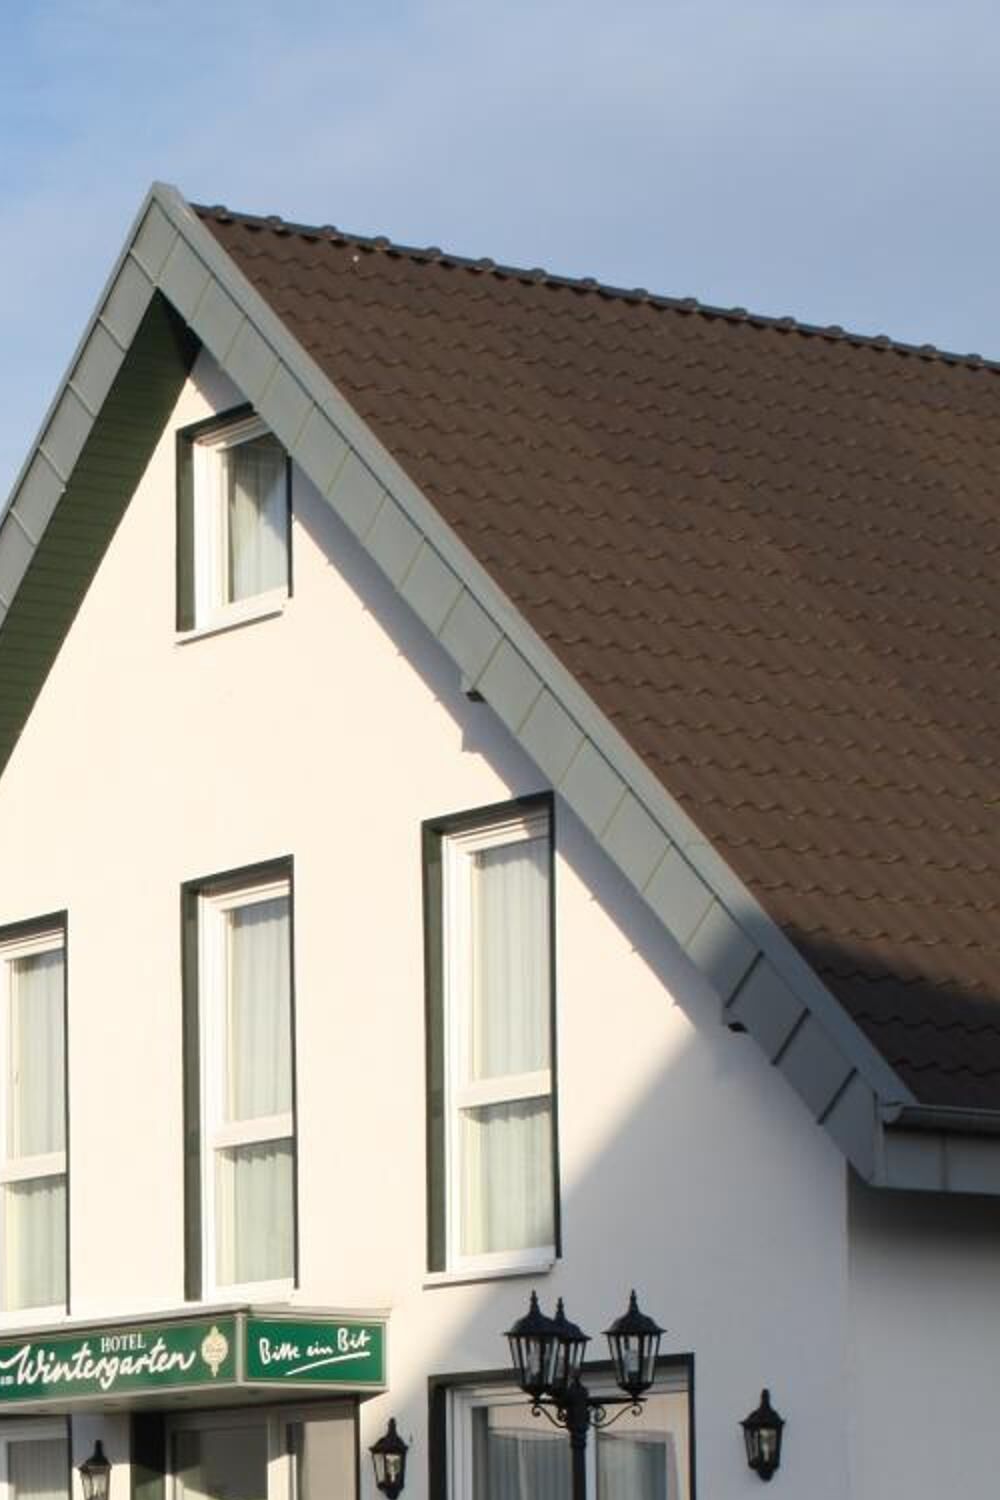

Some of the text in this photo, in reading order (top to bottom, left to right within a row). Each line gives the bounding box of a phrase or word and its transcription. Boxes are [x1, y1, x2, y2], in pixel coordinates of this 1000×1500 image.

[101, 1333, 146, 1353] HOTEL
[306, 1340, 333, 1357] ein
[337, 1327, 371, 1352] Bit
